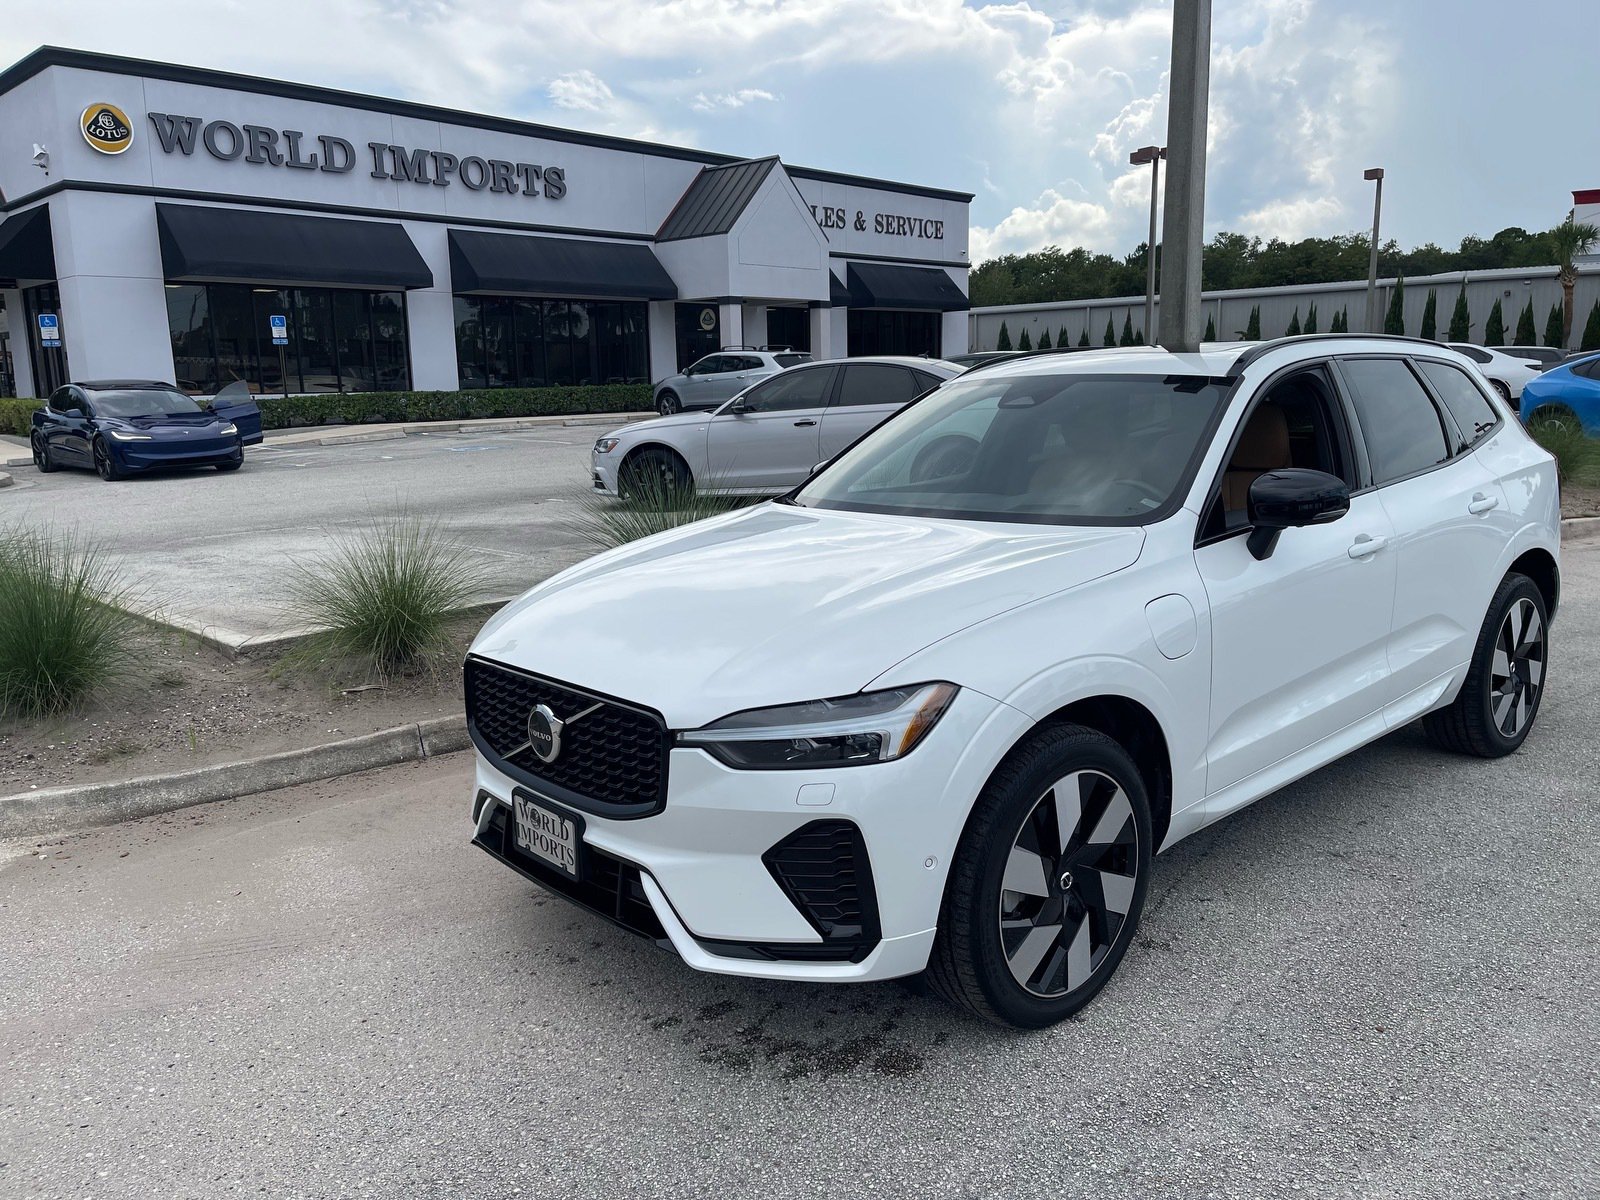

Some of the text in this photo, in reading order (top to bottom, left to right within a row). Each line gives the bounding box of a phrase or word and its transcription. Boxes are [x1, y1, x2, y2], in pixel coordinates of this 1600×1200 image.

[89, 125, 128, 138] LOTUS
[148, 112, 567, 199] WORLD IMPORTS
[854, 210, 866, 231] &
[874, 213, 943, 239] SERVICE
[516, 821, 574, 866] IMPORTS
